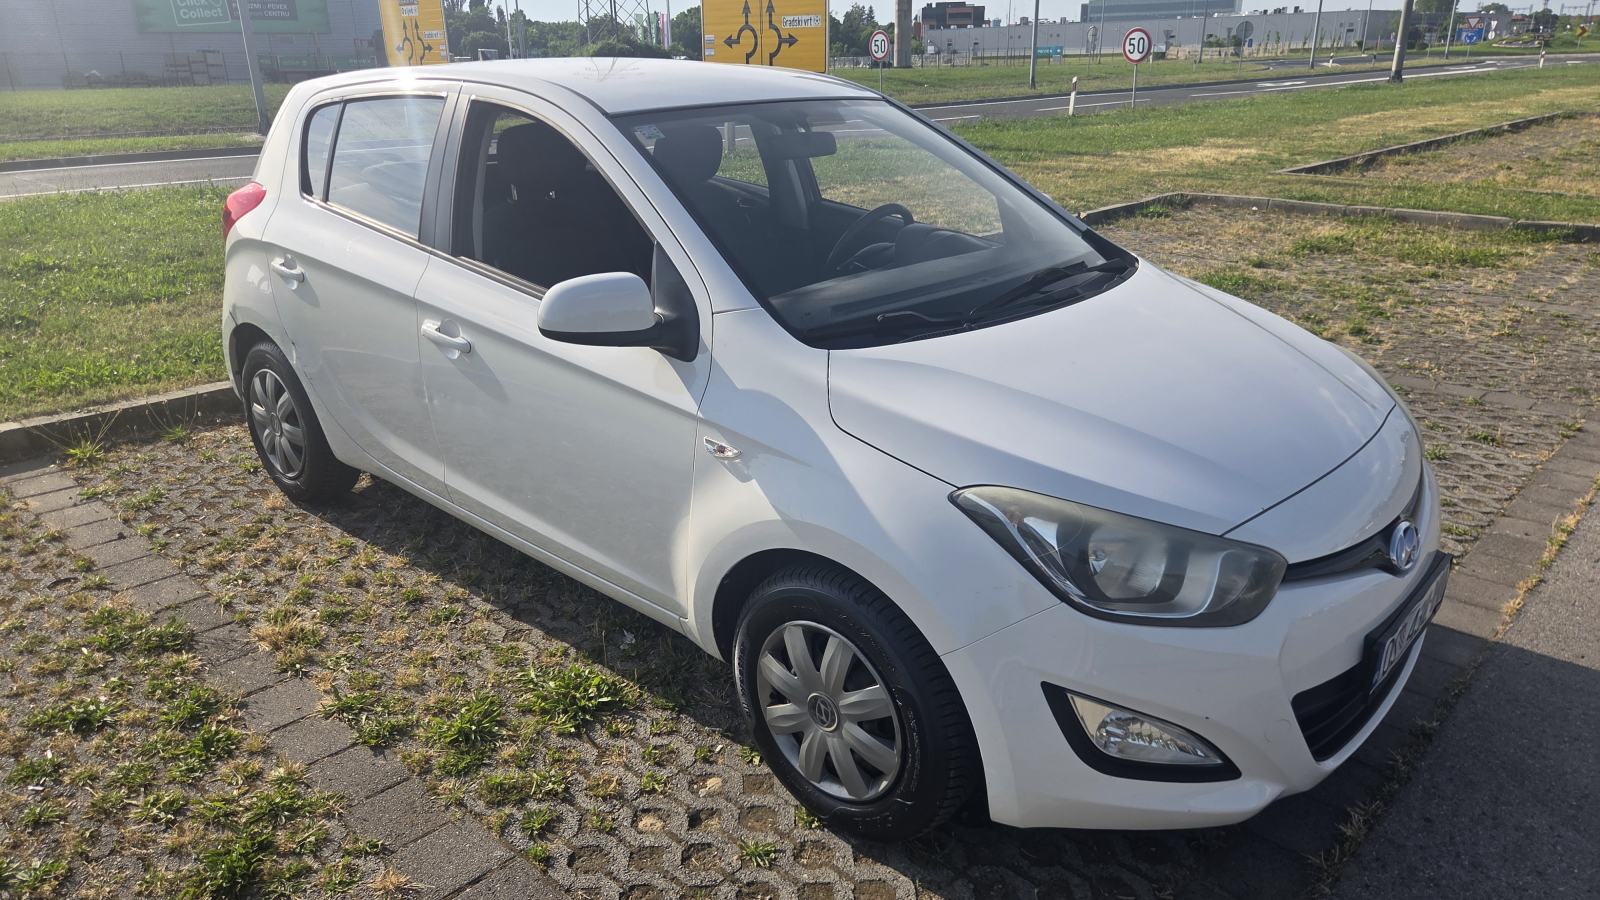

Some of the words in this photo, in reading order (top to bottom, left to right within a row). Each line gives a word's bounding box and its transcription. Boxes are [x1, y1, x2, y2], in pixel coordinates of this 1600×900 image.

[180, 8, 223, 19] Collect
[782, 16, 803, 27] Gradski
[803, 16, 813, 26] vrt
[873, 39, 886, 54] 50
[1128, 37, 1145, 54] 50
